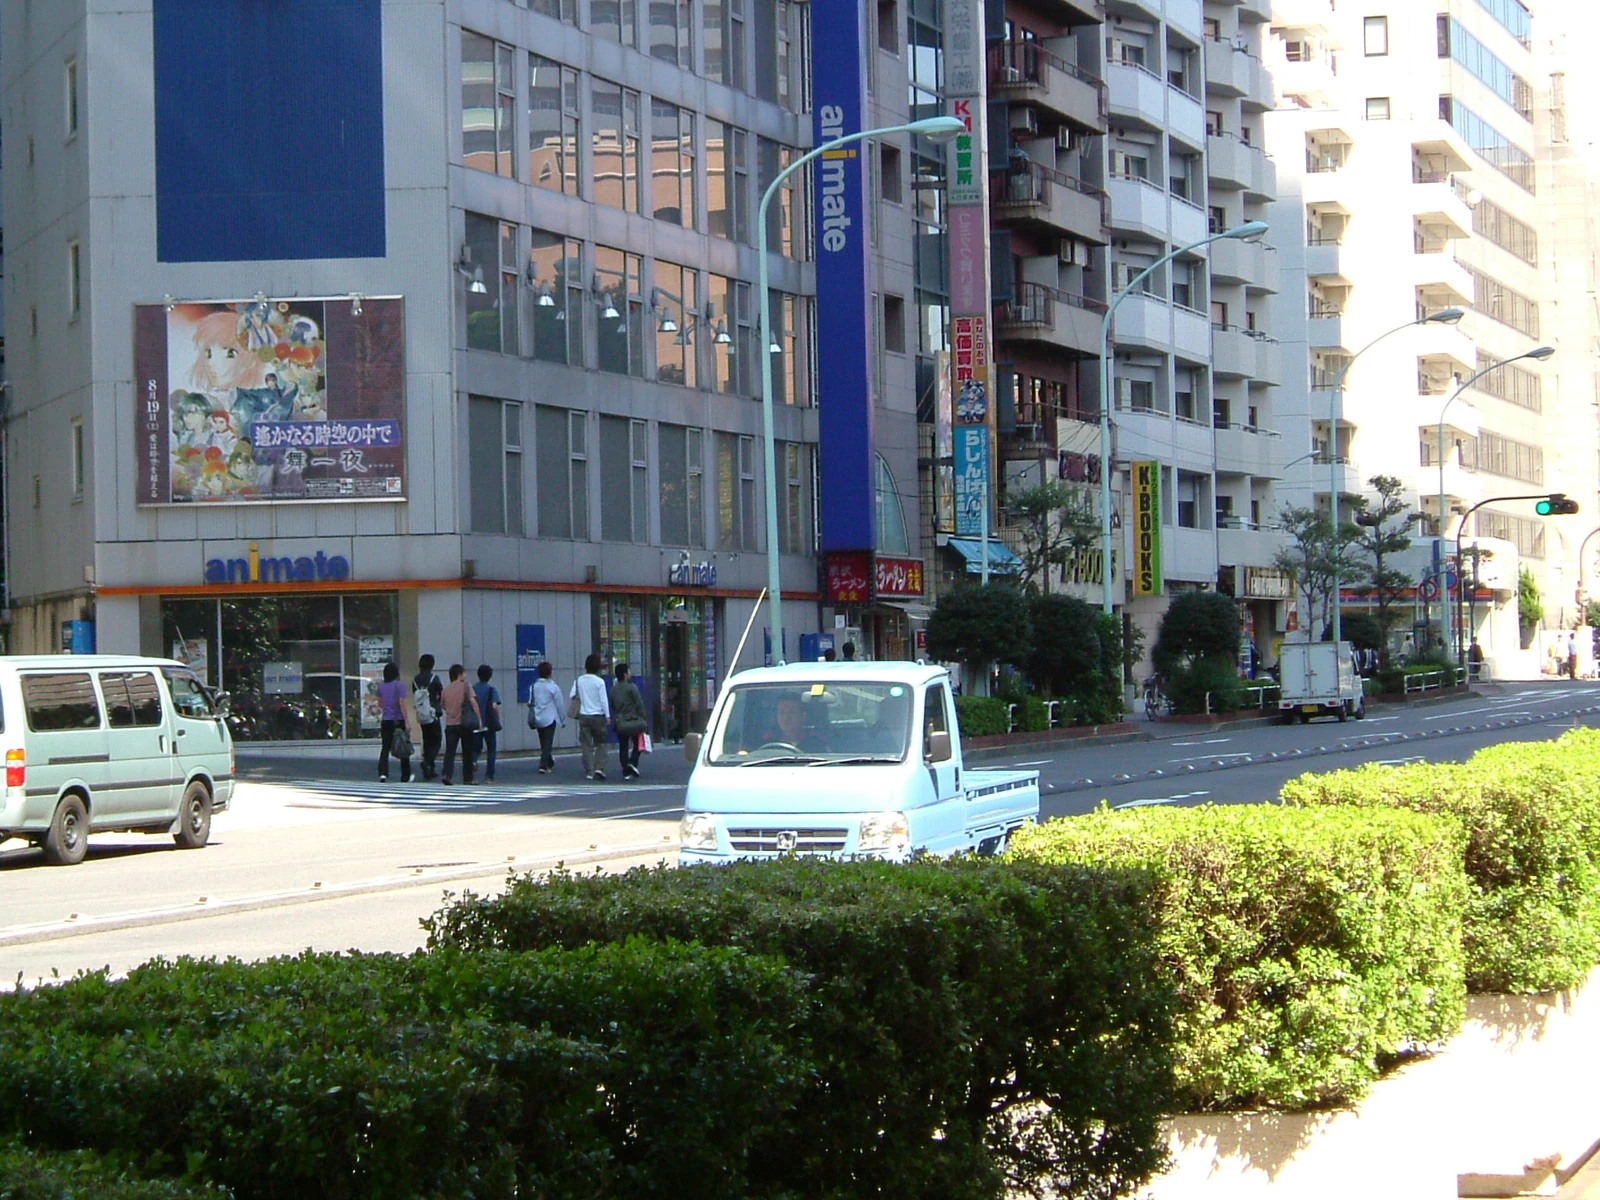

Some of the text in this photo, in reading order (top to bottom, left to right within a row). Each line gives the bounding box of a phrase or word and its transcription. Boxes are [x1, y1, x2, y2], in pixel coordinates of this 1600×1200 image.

[820, 105, 857, 253] animate
[956, 317, 973, 381] 高価買取
[281, 448, 367, 474] 舞一夜
[205, 543, 350, 584] animate
[670, 558, 717, 586] animate
[876, 563, 906, 591] ラーメン
